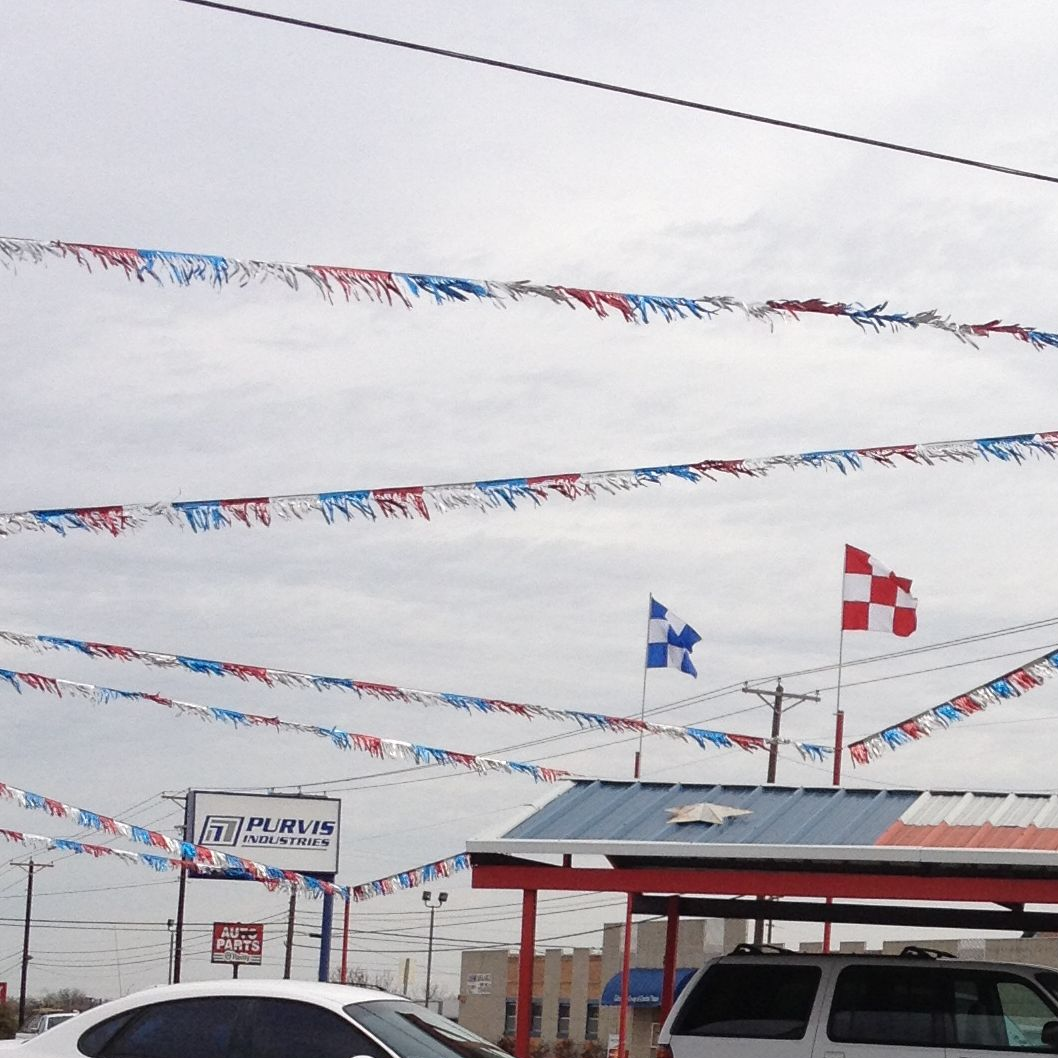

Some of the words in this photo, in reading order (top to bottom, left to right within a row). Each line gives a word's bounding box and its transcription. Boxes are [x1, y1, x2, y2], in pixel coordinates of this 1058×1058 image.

[246, 817, 336, 836] PURVIS
[242, 834, 330, 847] INDUSTRIES
[216, 938, 260, 952] PARTS
